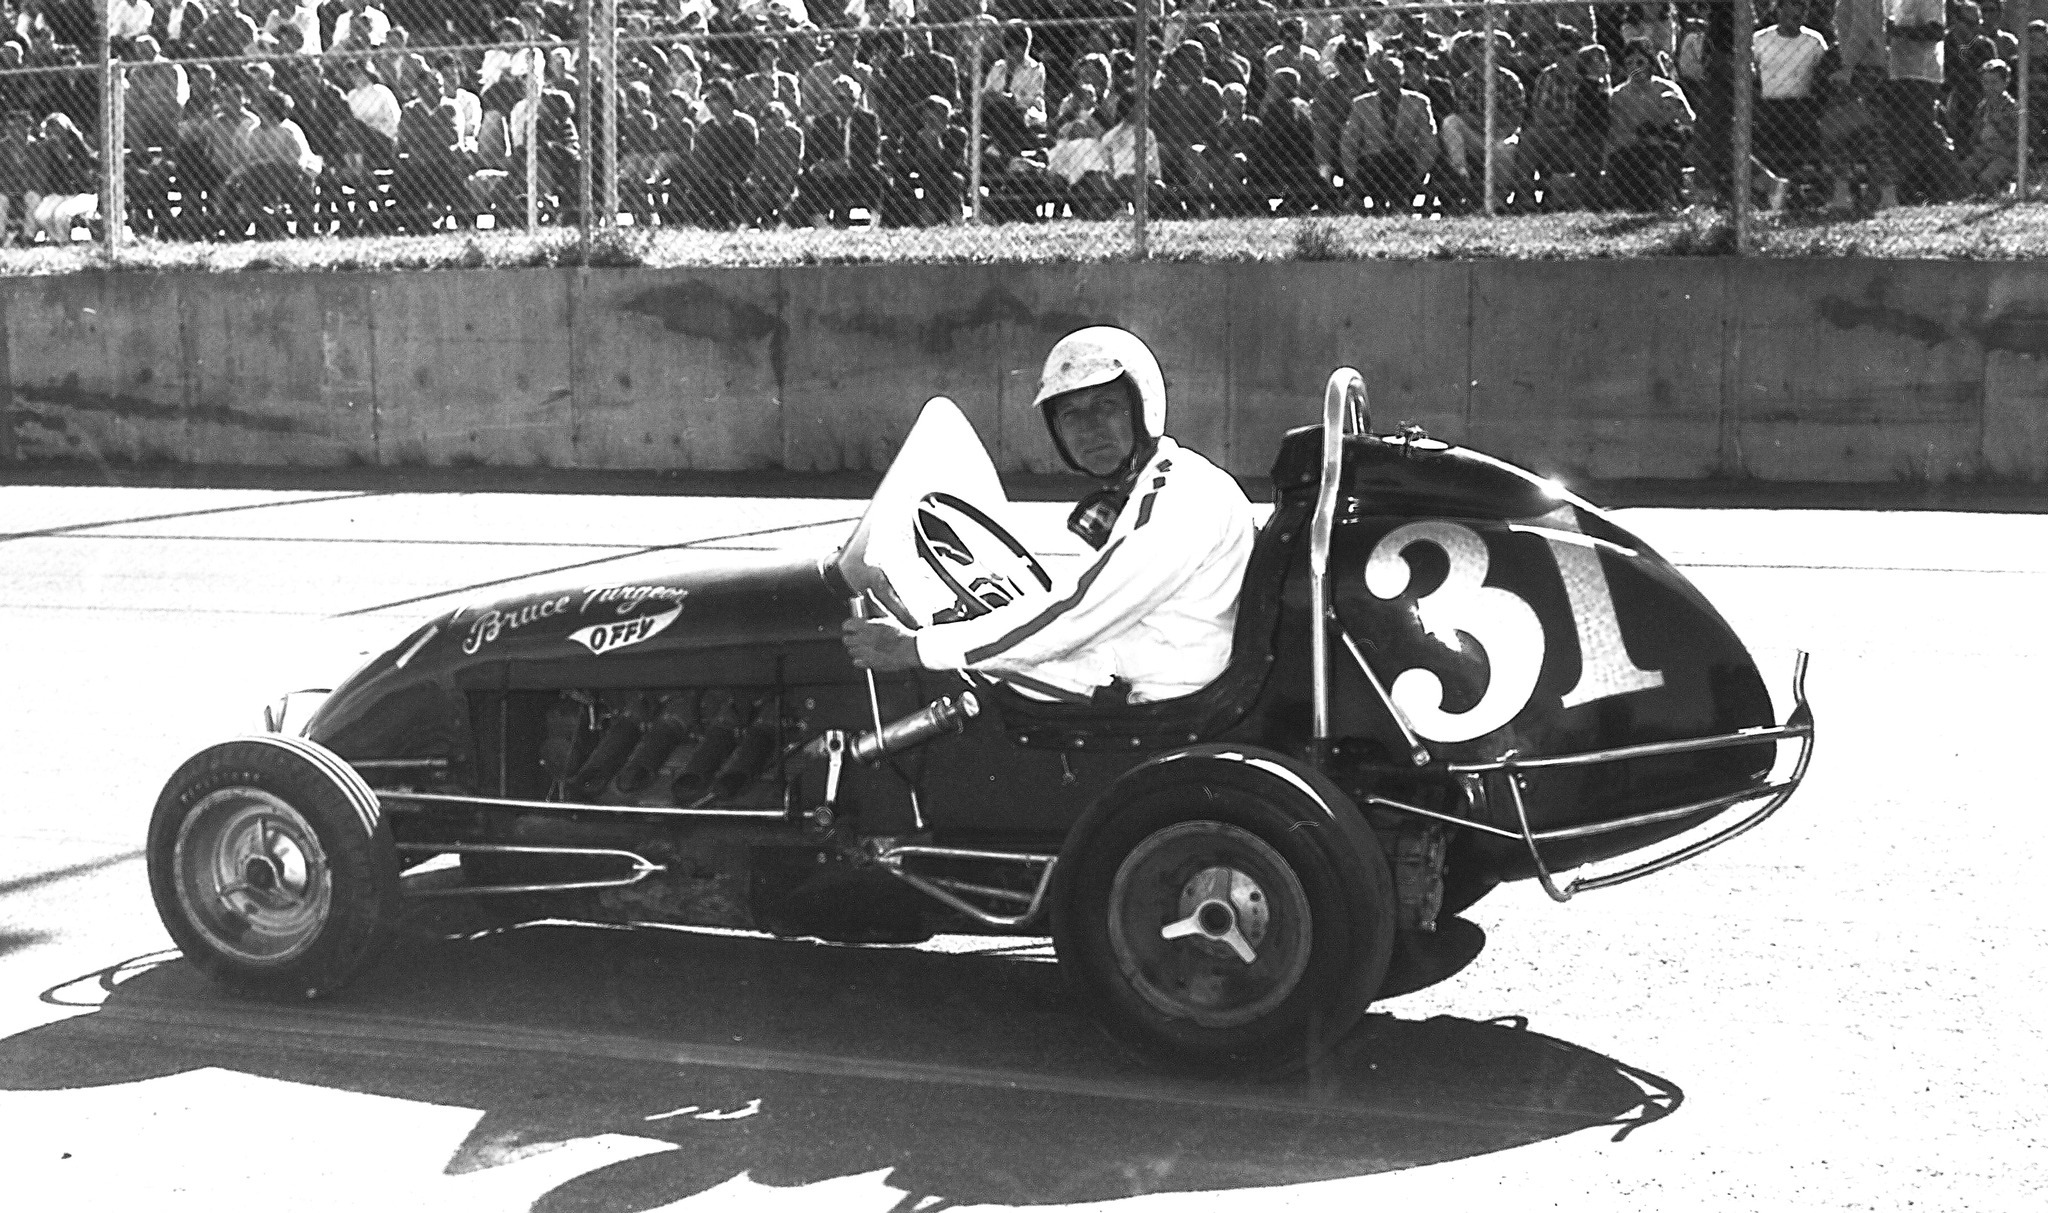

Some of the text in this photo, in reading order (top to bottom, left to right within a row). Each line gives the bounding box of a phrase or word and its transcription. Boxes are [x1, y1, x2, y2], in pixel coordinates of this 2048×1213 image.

[463, 595, 570, 655] Bruce
[589, 616, 655, 650] OFFY
[1365, 504, 1665, 743] 31
